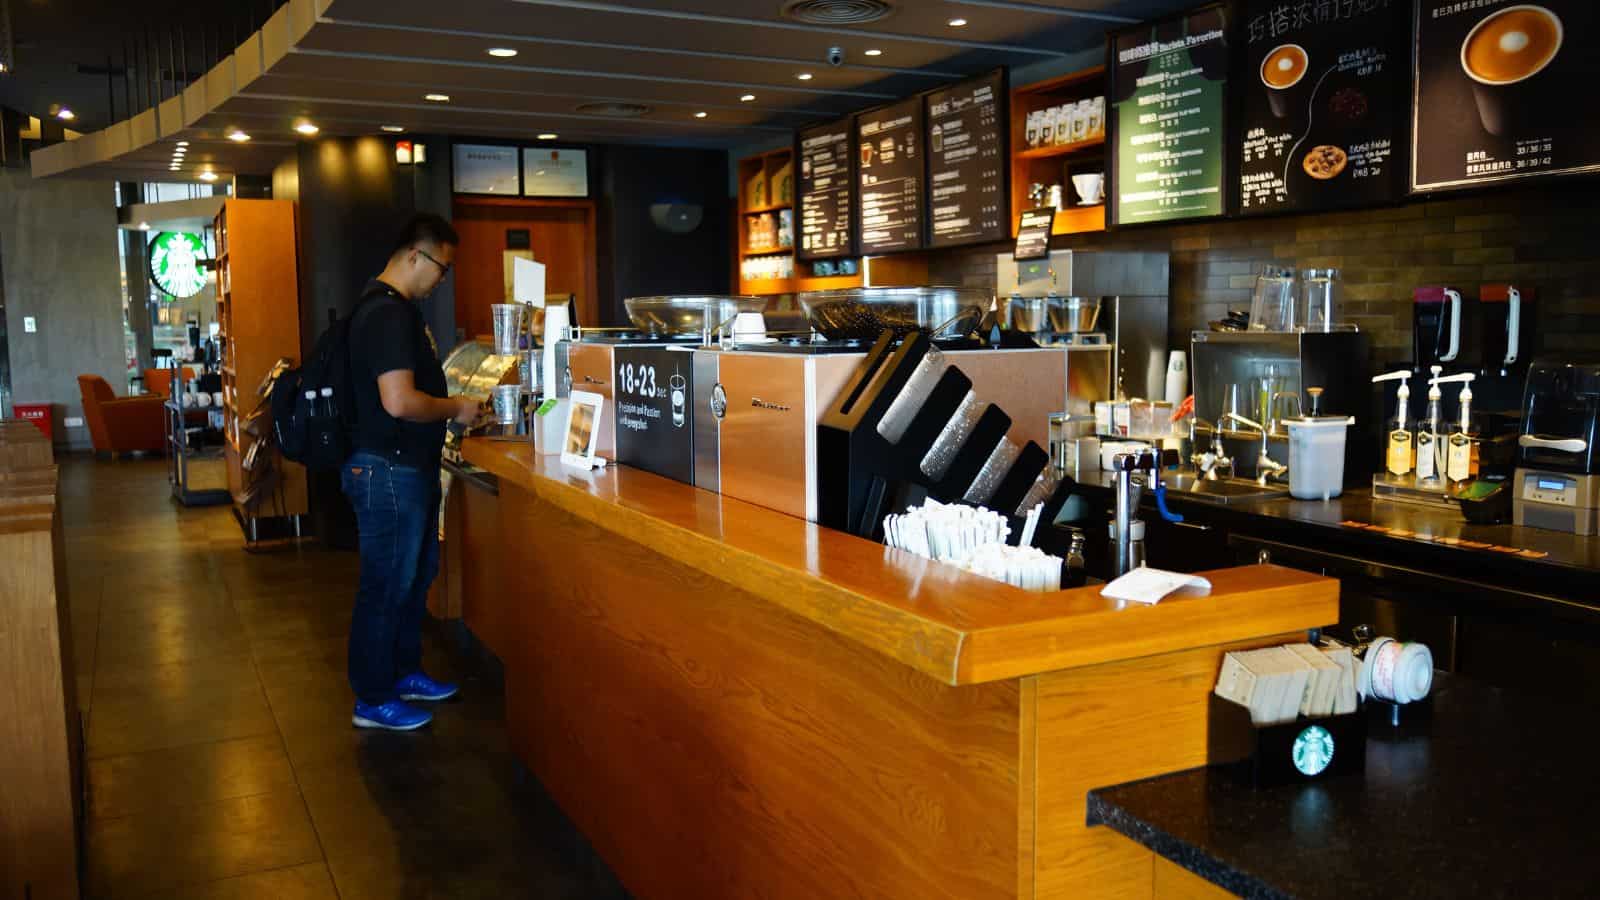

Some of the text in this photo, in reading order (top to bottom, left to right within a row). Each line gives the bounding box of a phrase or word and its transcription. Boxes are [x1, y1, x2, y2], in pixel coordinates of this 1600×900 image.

[1186, 29, 1223, 45] Favorites
[1353, 167, 1368, 179] RMB
[619, 363, 656, 398] 18-23
